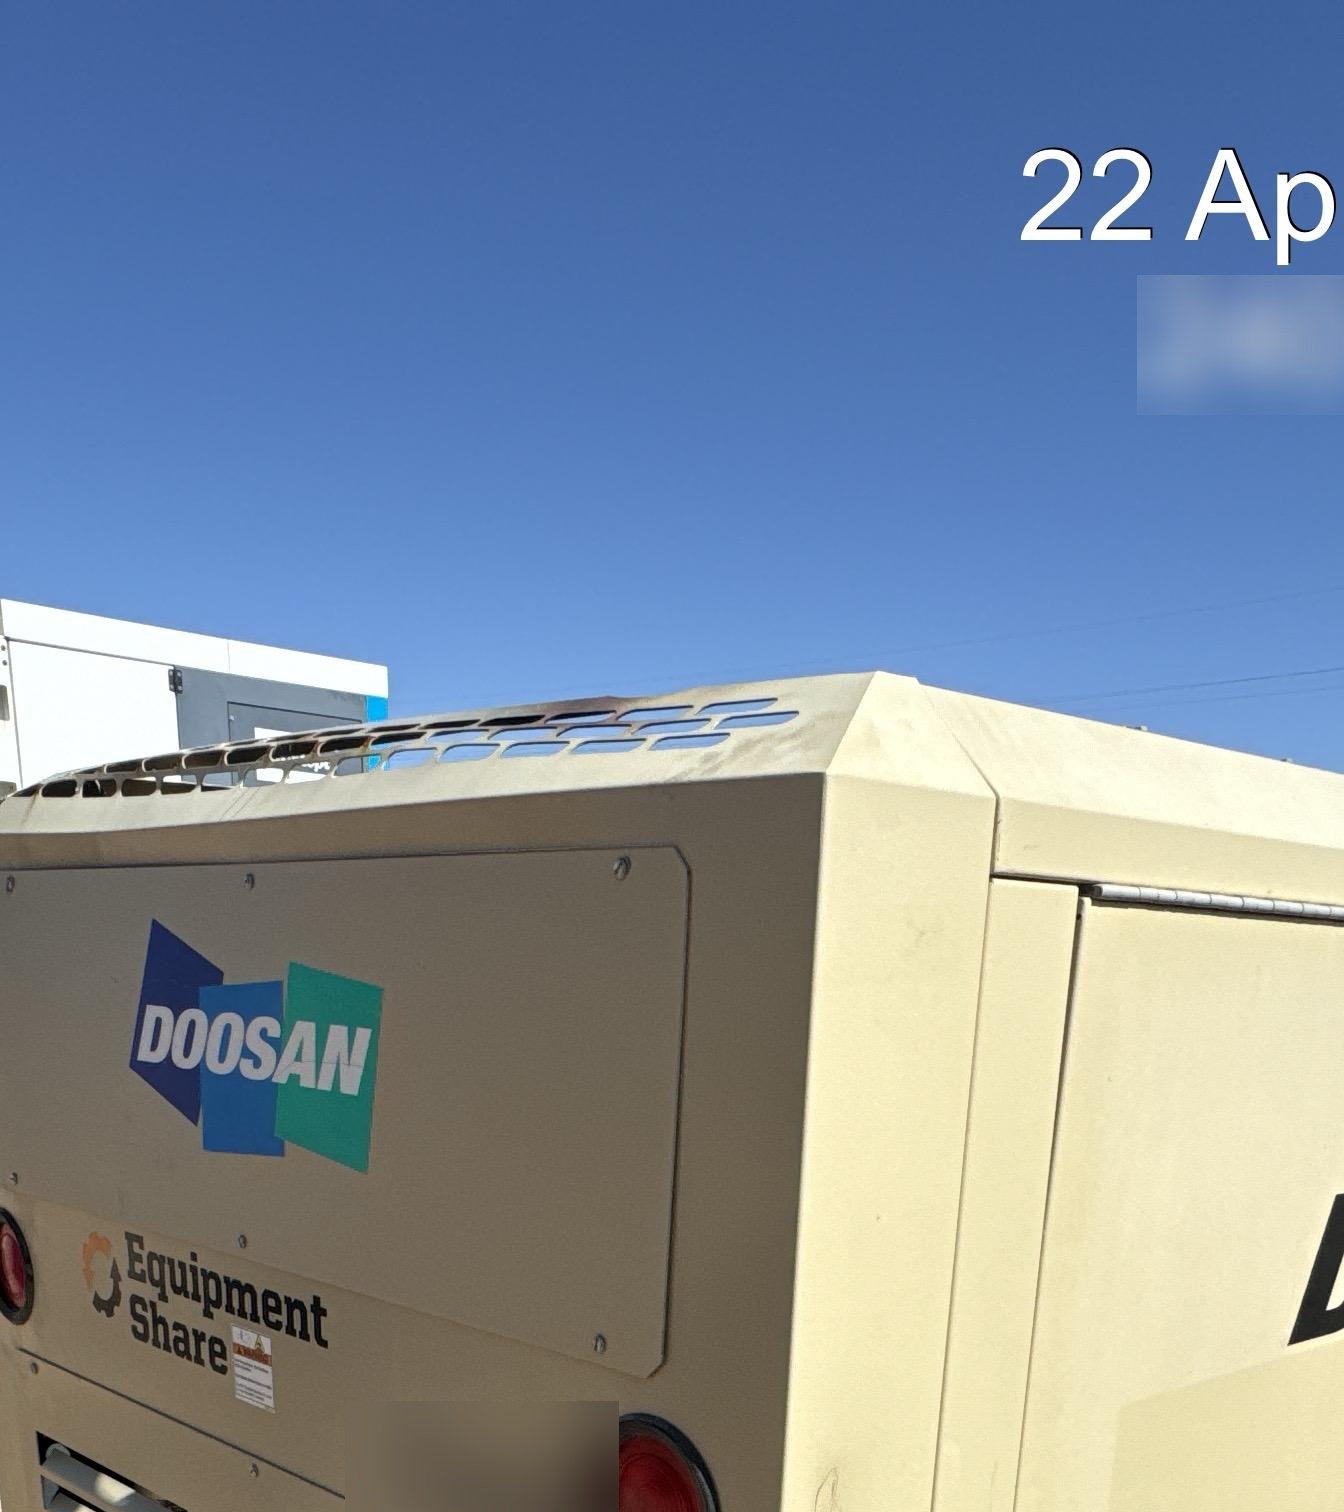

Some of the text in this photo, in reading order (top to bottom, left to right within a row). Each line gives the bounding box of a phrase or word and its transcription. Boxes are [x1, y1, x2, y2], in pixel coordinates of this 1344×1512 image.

[136, 1004, 373, 1096] DOOSAN
[124, 1231, 329, 1349] Equipment
[129, 1294, 228, 1376] Share
